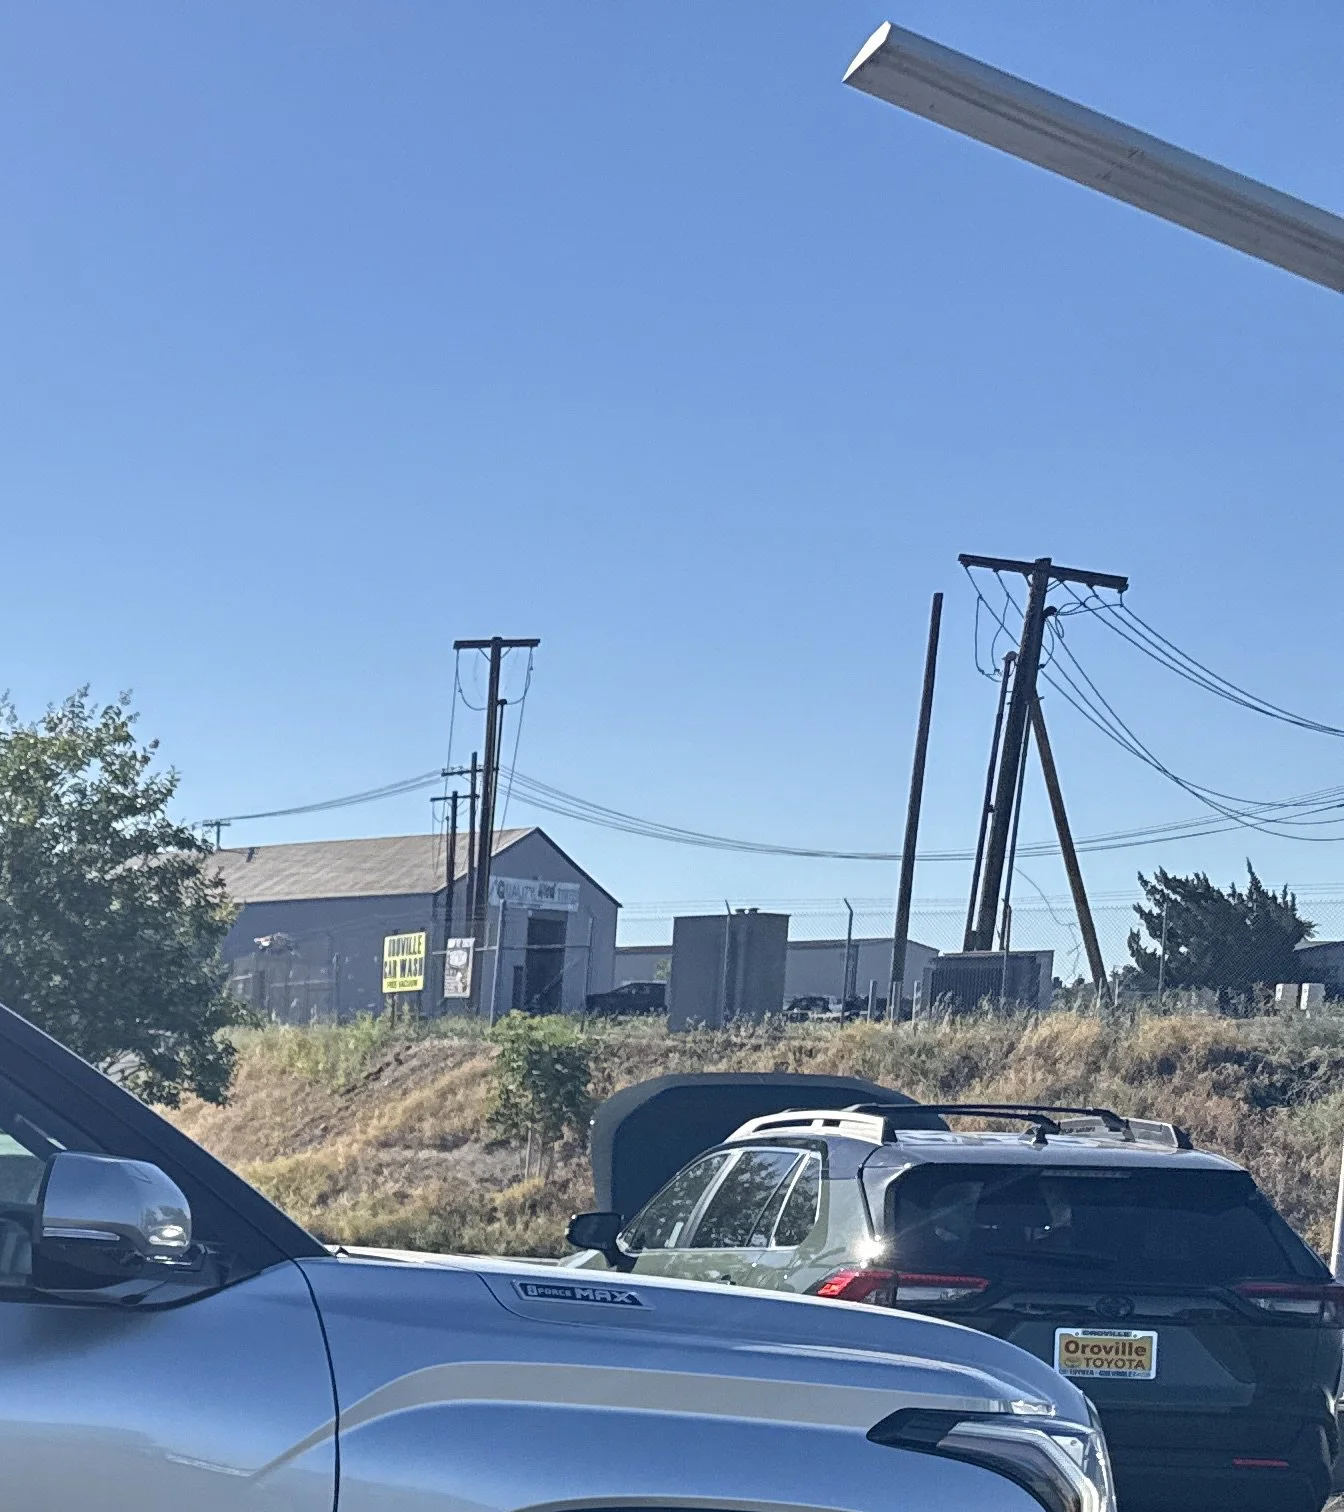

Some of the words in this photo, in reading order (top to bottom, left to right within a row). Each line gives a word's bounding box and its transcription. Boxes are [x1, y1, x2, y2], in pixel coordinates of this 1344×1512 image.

[573, 1287, 638, 1304] MAX
[1064, 1340, 1147, 1357] Oroville
[1084, 1357, 1145, 1370] TOYOTA
